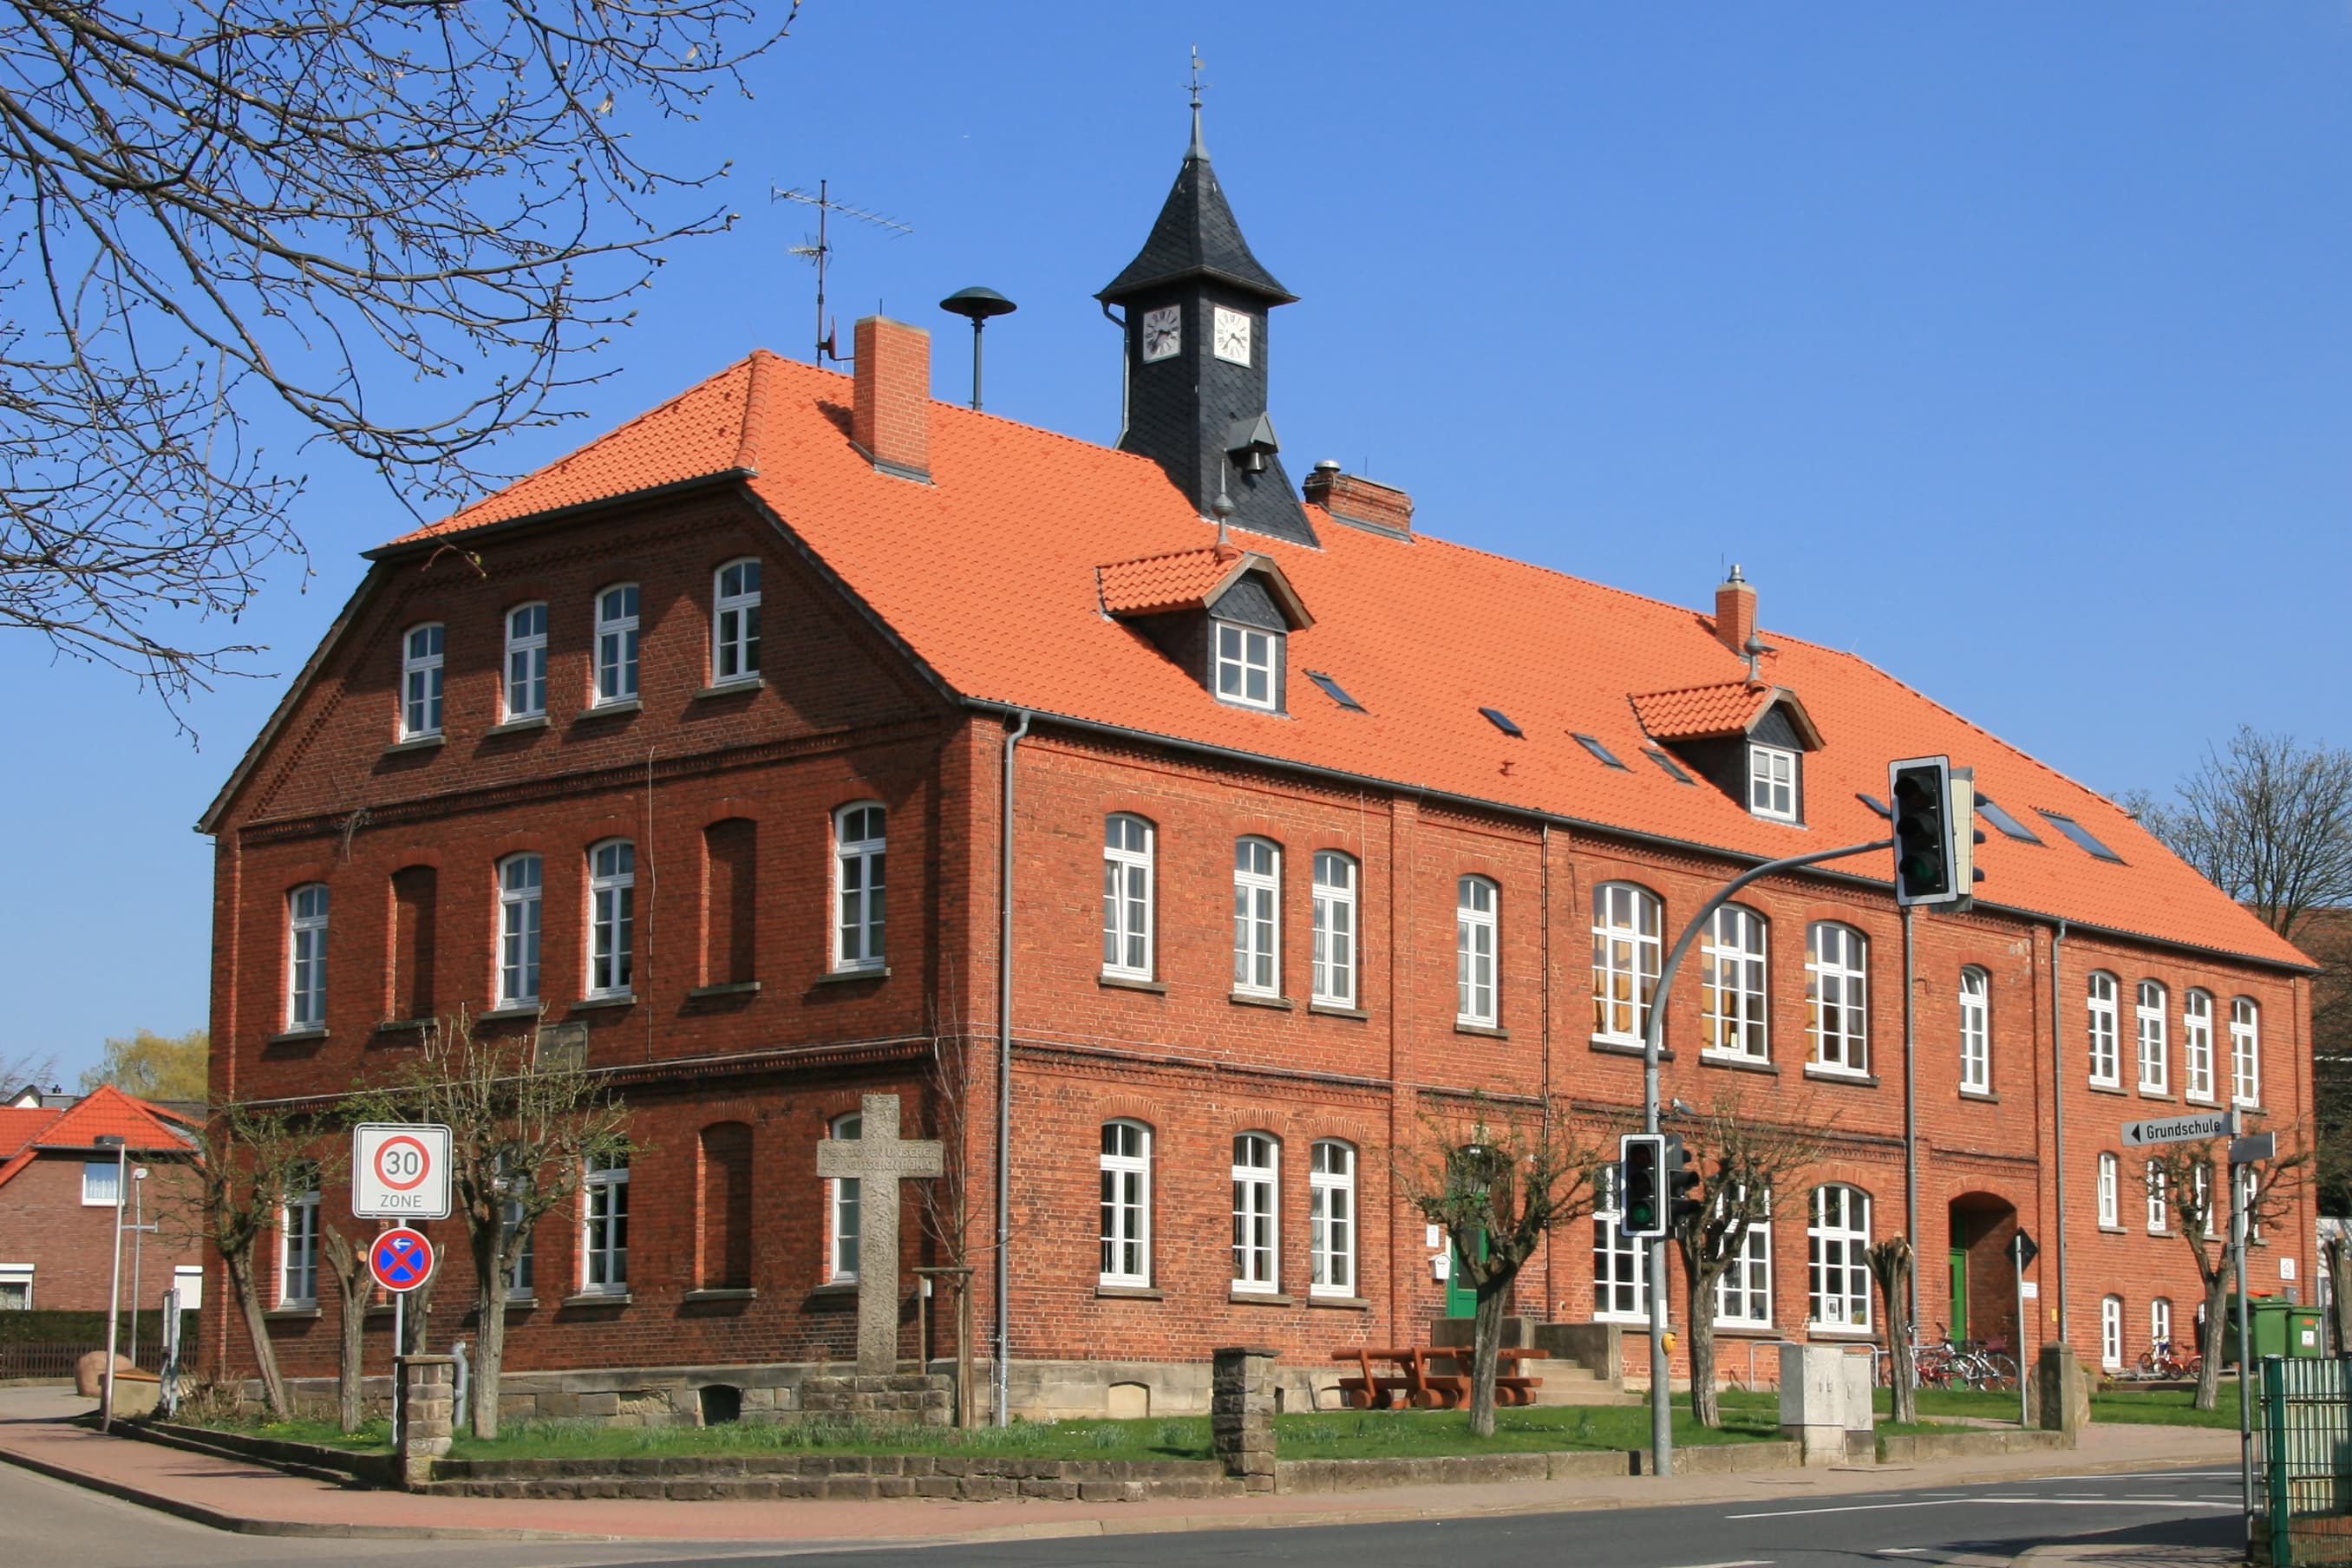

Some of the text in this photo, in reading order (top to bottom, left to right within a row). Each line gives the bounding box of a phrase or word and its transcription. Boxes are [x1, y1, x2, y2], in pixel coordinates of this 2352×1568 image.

[2146, 1118, 2221, 1140] Grundschule
[386, 1151, 419, 1175] 30
[380, 1194, 422, 1208] ZONE
